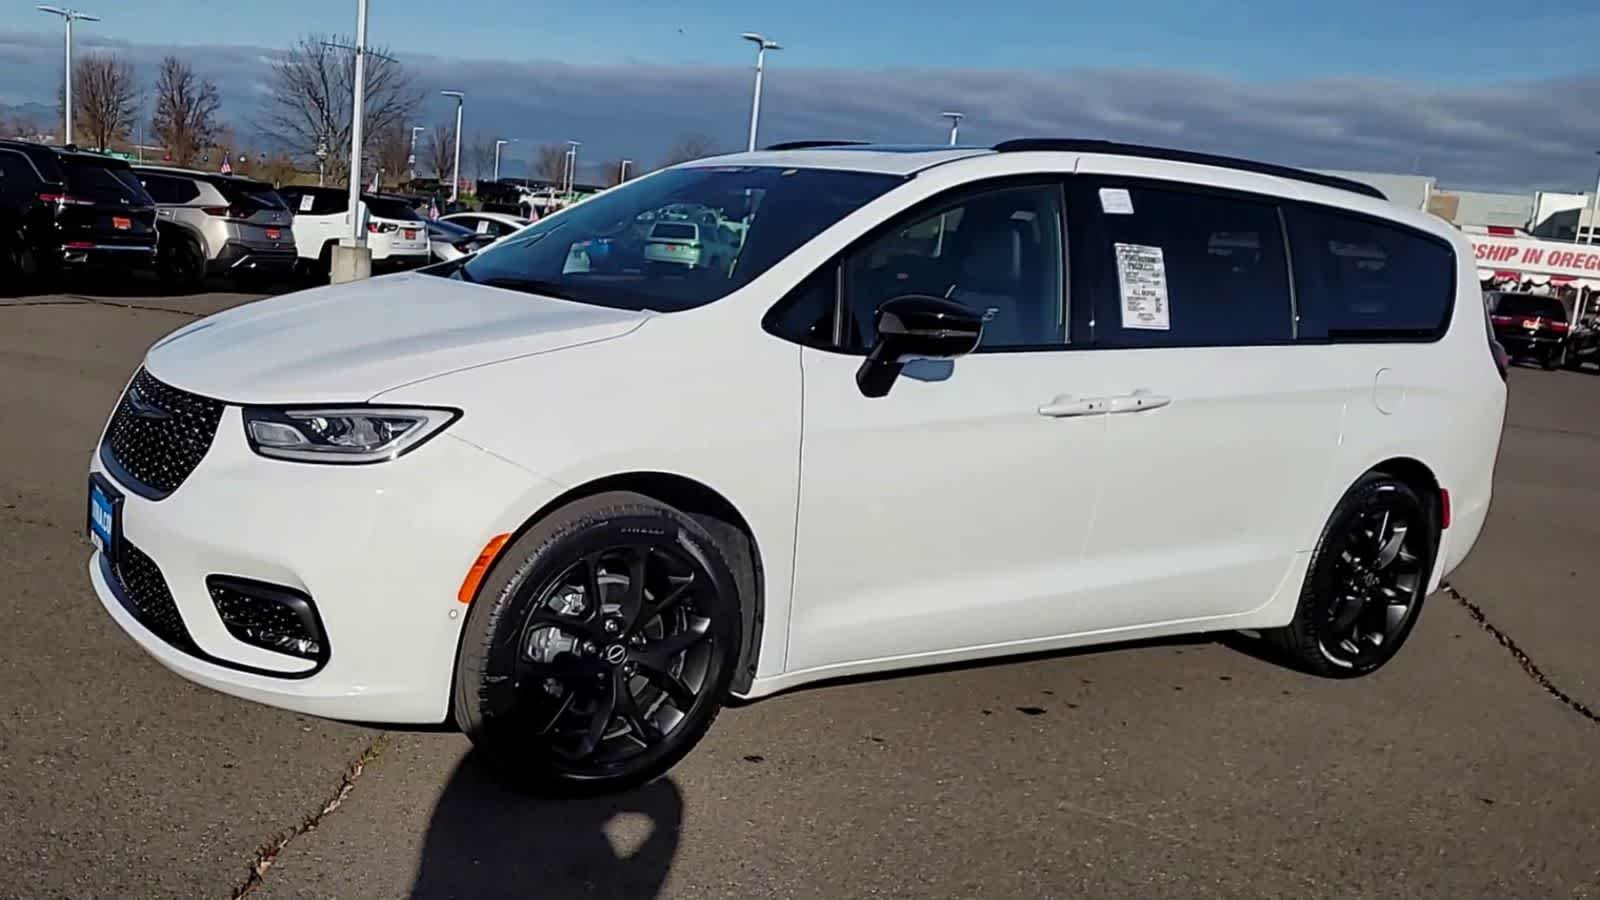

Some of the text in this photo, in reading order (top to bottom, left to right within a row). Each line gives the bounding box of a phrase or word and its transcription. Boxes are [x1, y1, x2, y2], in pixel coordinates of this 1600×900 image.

[1472, 243, 1600, 270] SHIP IN OREG
